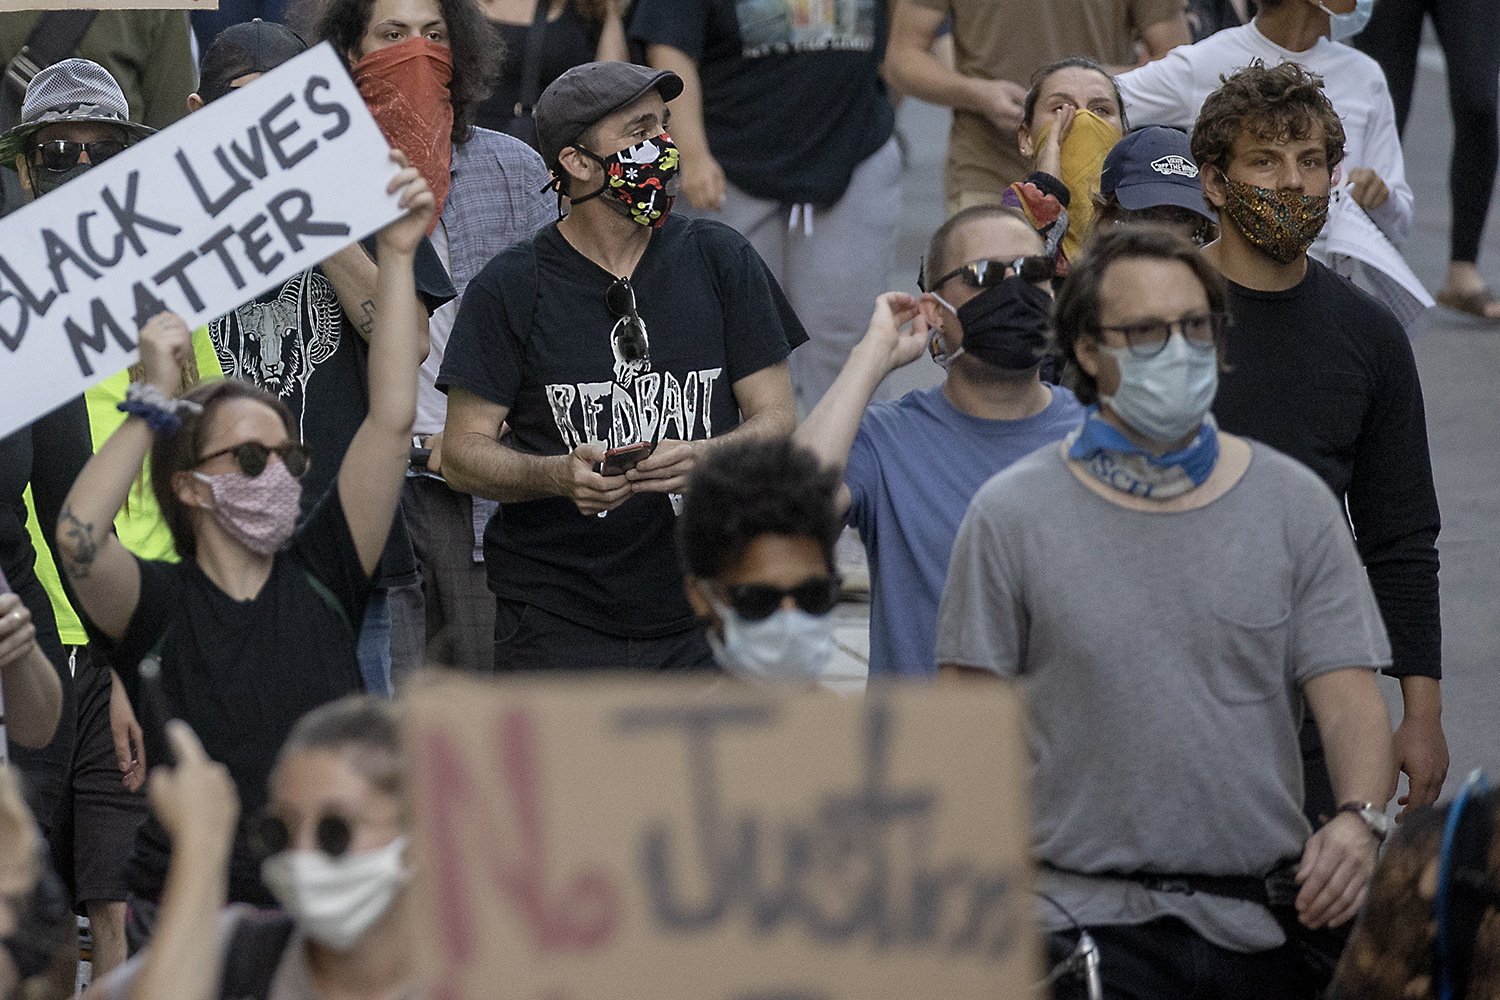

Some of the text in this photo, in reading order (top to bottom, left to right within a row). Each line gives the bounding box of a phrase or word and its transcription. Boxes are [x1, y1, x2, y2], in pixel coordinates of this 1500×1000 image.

[174, 74, 352, 218] LIVES
[1166, 157, 1184, 166] VANS
[62, 187, 351, 378] MATTER
[545, 367, 722, 454] REDBAIT
